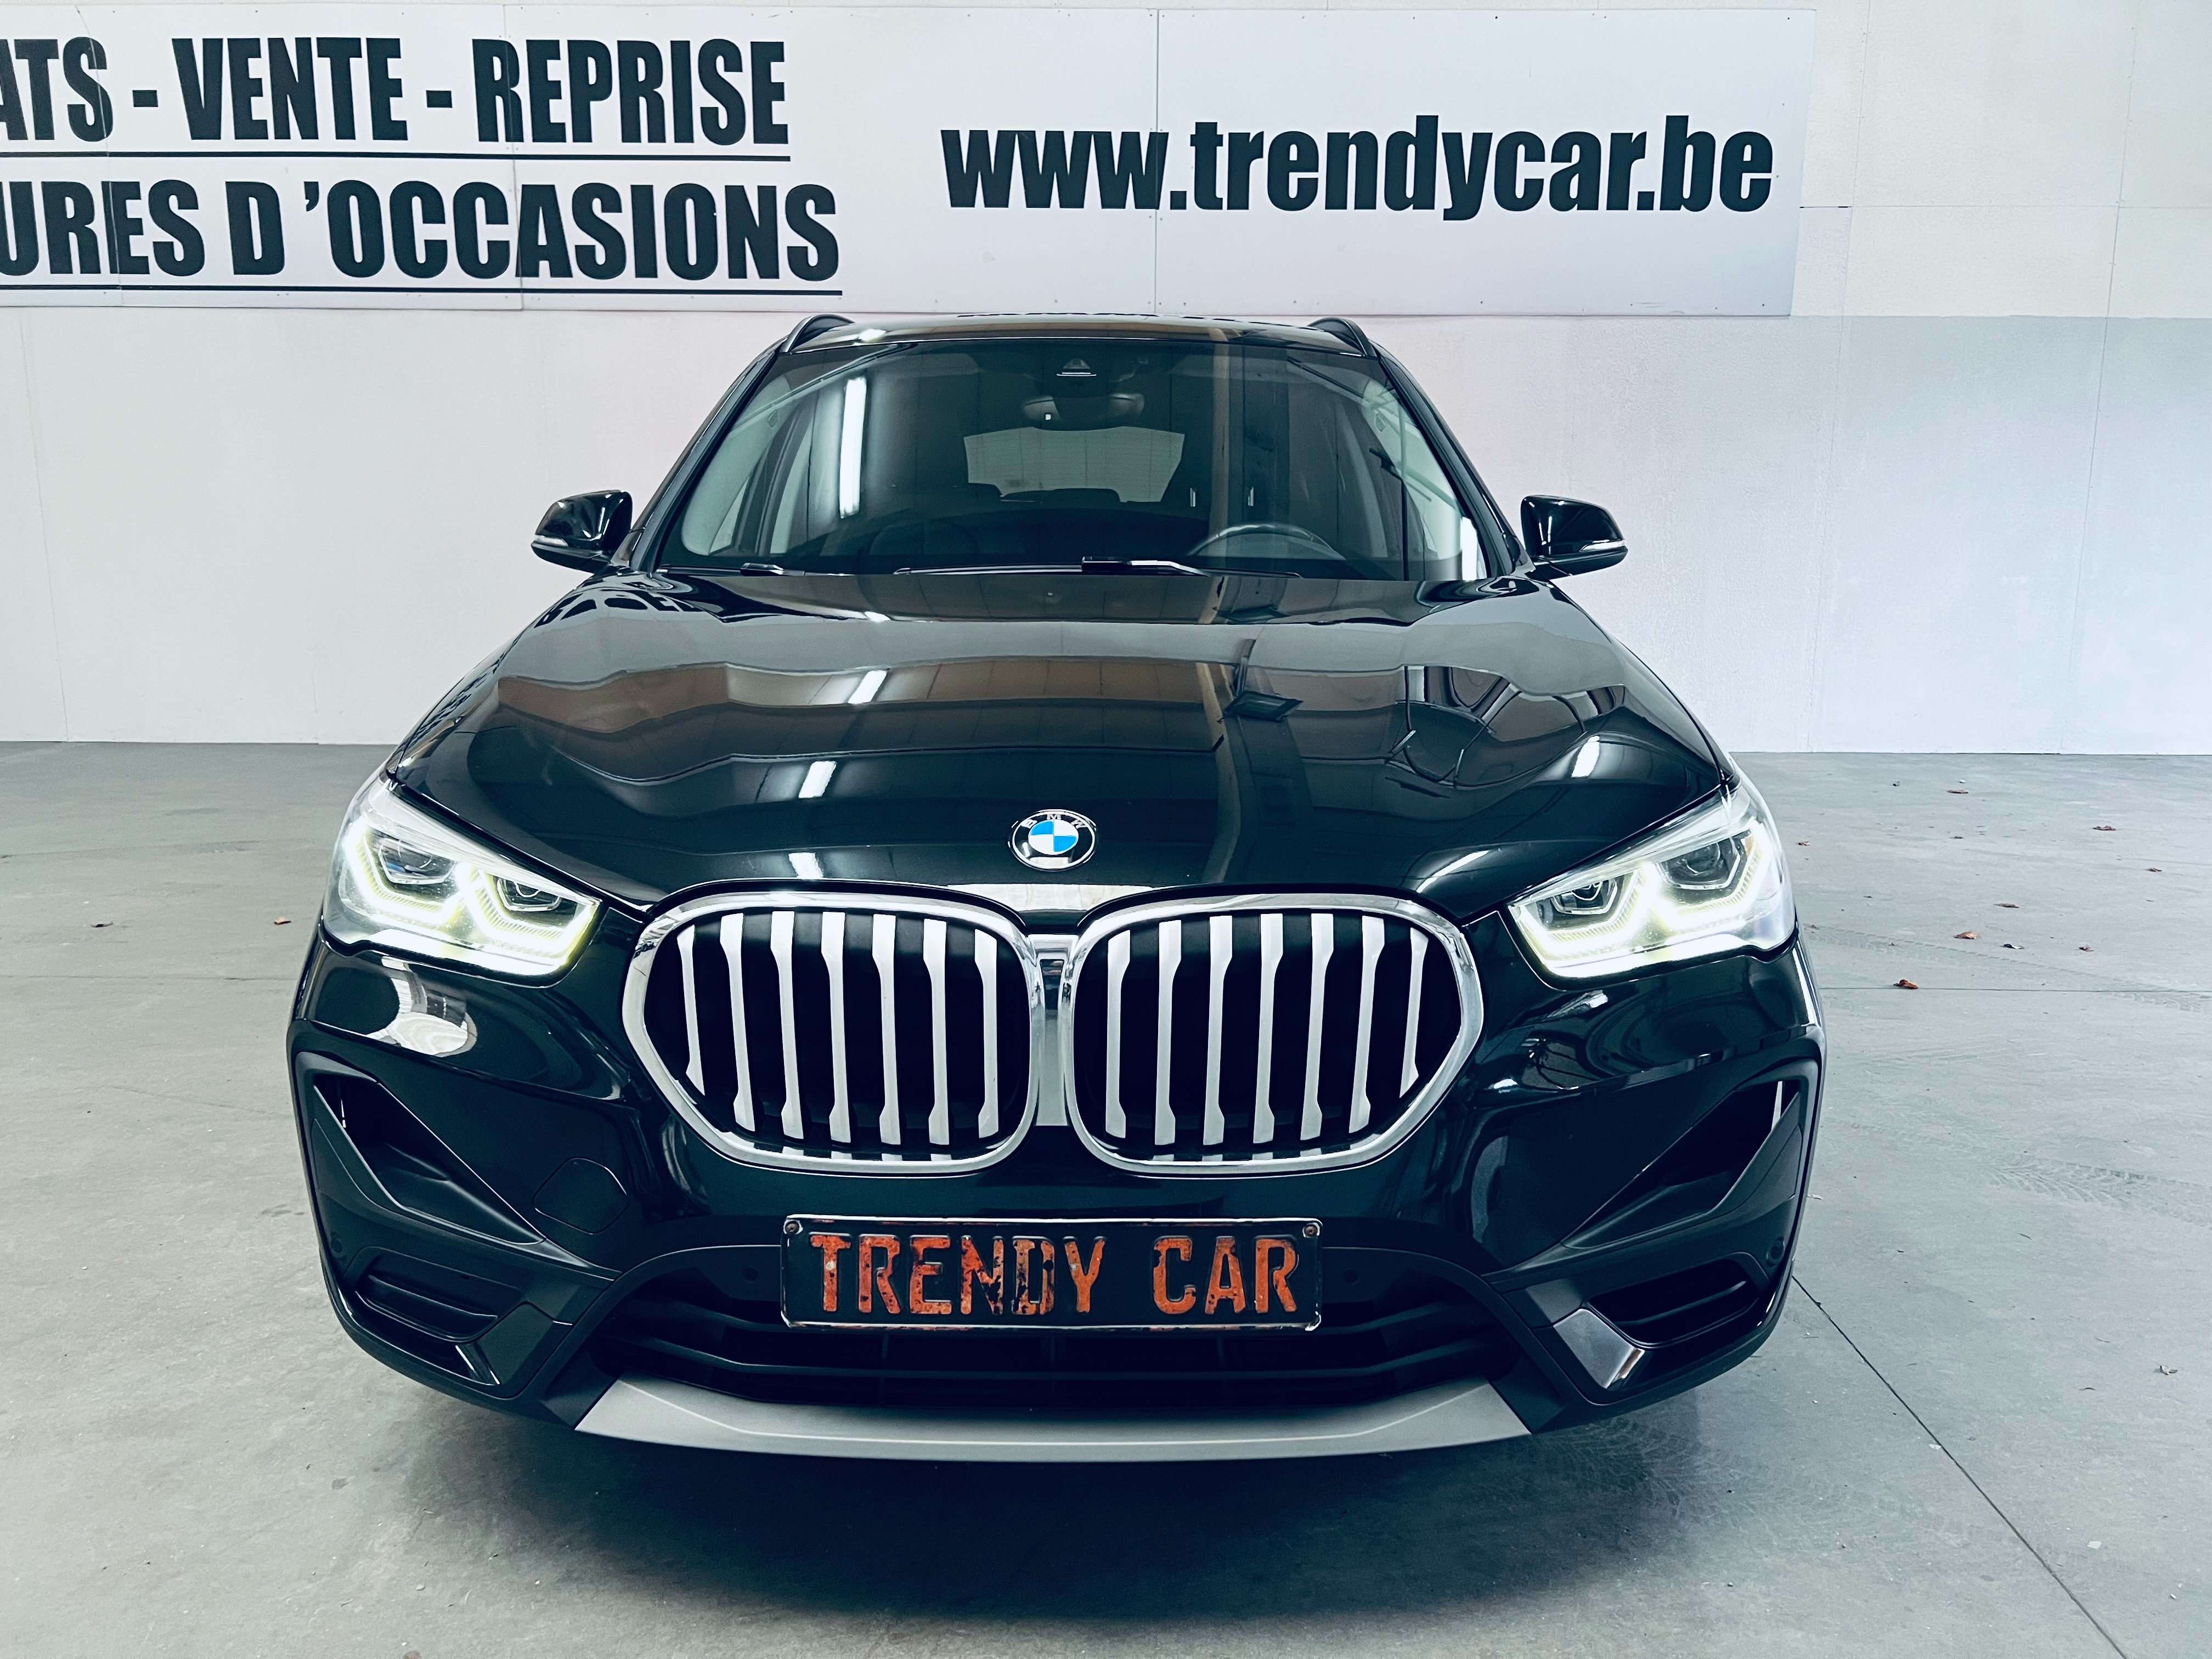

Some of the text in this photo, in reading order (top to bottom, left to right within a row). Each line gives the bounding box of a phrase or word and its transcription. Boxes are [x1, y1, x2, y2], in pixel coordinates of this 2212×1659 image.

[132, 89, 159, 108] -
[171, 37, 408, 141] VENTE
[426, 90, 453, 109] -
[472, 38, 788, 146] REPRISE
[940, 115, 1773, 221] www.trendycar.be
[1021, 814, 1088, 830] BMW
[810, 1234, 1299, 1315] TRENDY CAR
